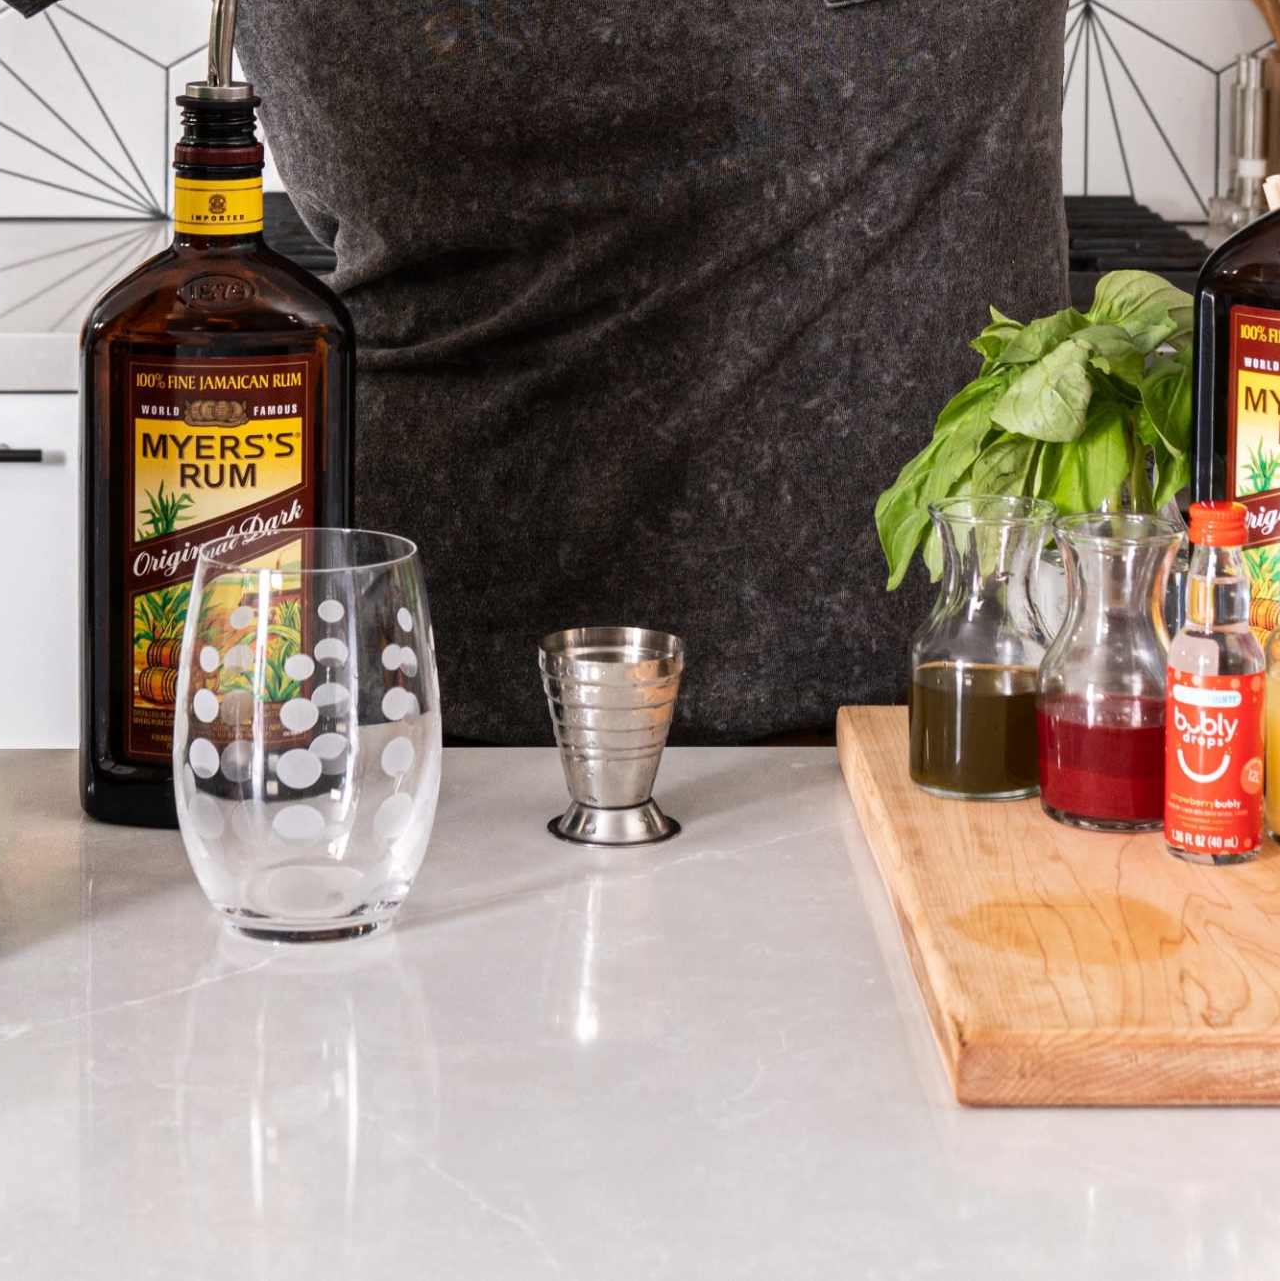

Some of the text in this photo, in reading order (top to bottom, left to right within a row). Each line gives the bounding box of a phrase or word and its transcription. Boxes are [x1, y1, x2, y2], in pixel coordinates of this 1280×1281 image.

[191, 214, 245, 222] IMPORTED
[1240, 324, 1267, 342] 100%
[1243, 356, 1280, 371] WORLD
[136, 372, 302, 391] 100% FINE JAMAICAN RUM
[141, 403, 298, 417] WORLD FAMOUS
[180, 463, 257, 488] RUM
[239, 498, 304, 544] Dark
[1174, 704, 1239, 743] bubly
[1183, 733, 1224, 750] drops
